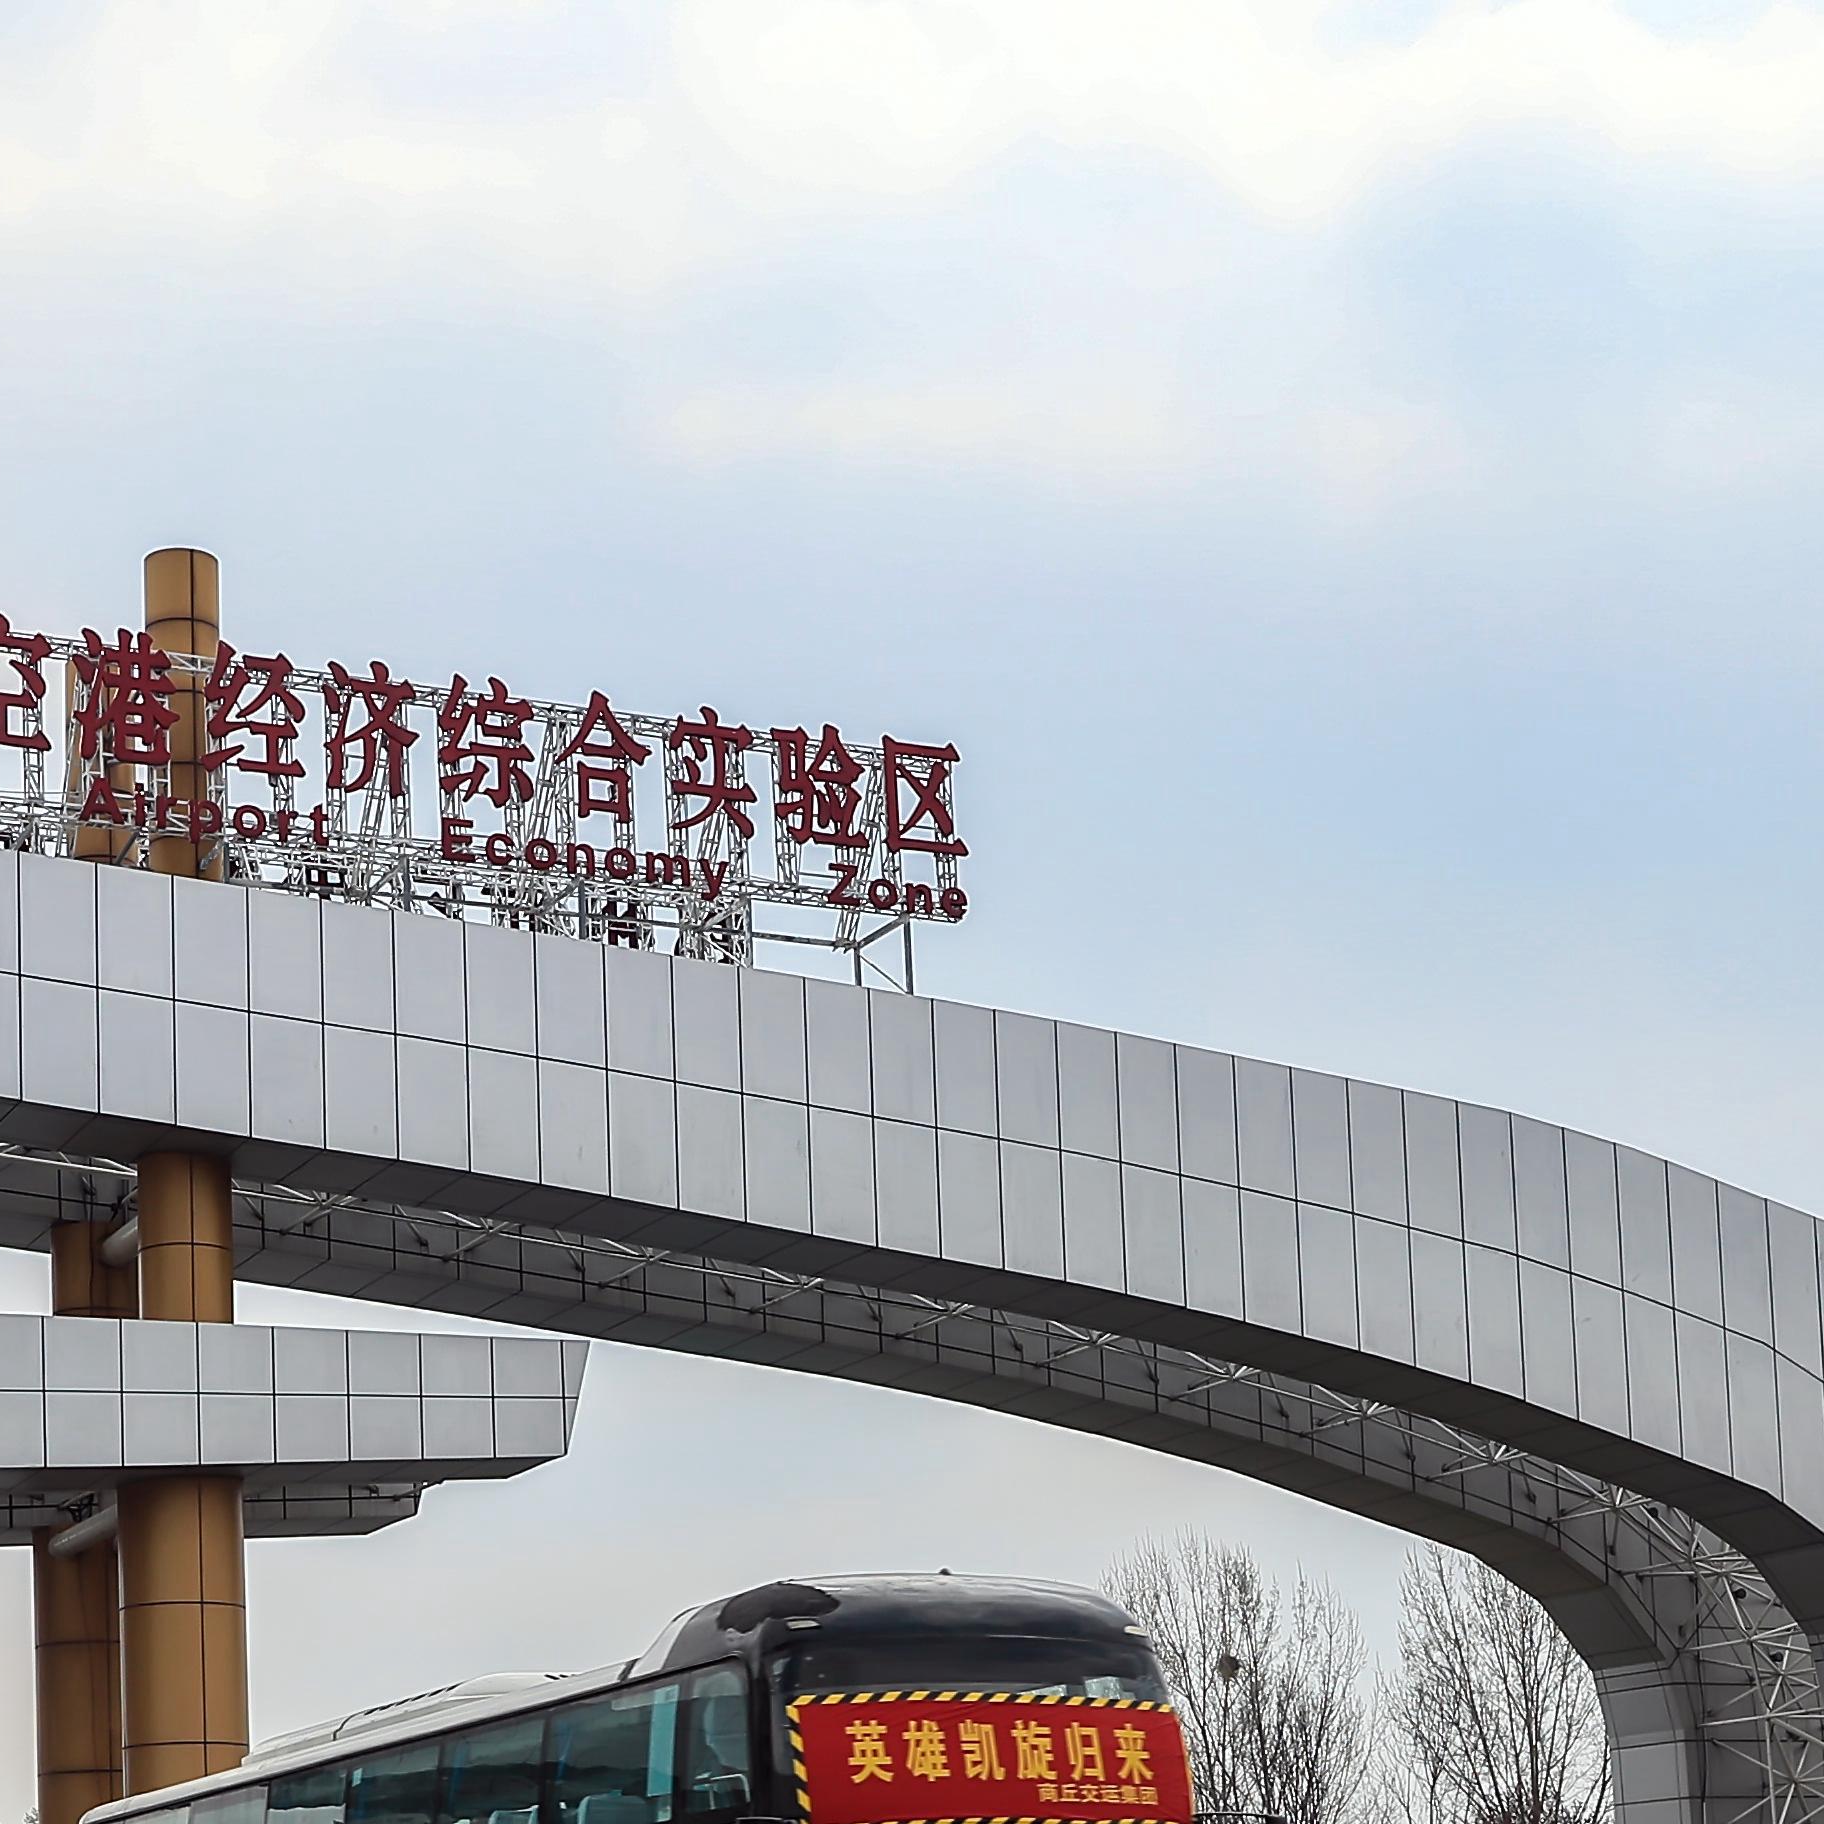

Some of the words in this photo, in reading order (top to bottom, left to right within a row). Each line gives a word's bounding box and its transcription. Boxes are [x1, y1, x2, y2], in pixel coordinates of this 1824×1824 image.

[79, 777, 329, 846] Airport
[442, 816, 730, 901] Economy
[827, 862, 969, 920] Zone
[844, 1719, 1156, 1784] 英雄凯旋归来
[1036, 1783, 1160, 1806] 商丘交运集团
